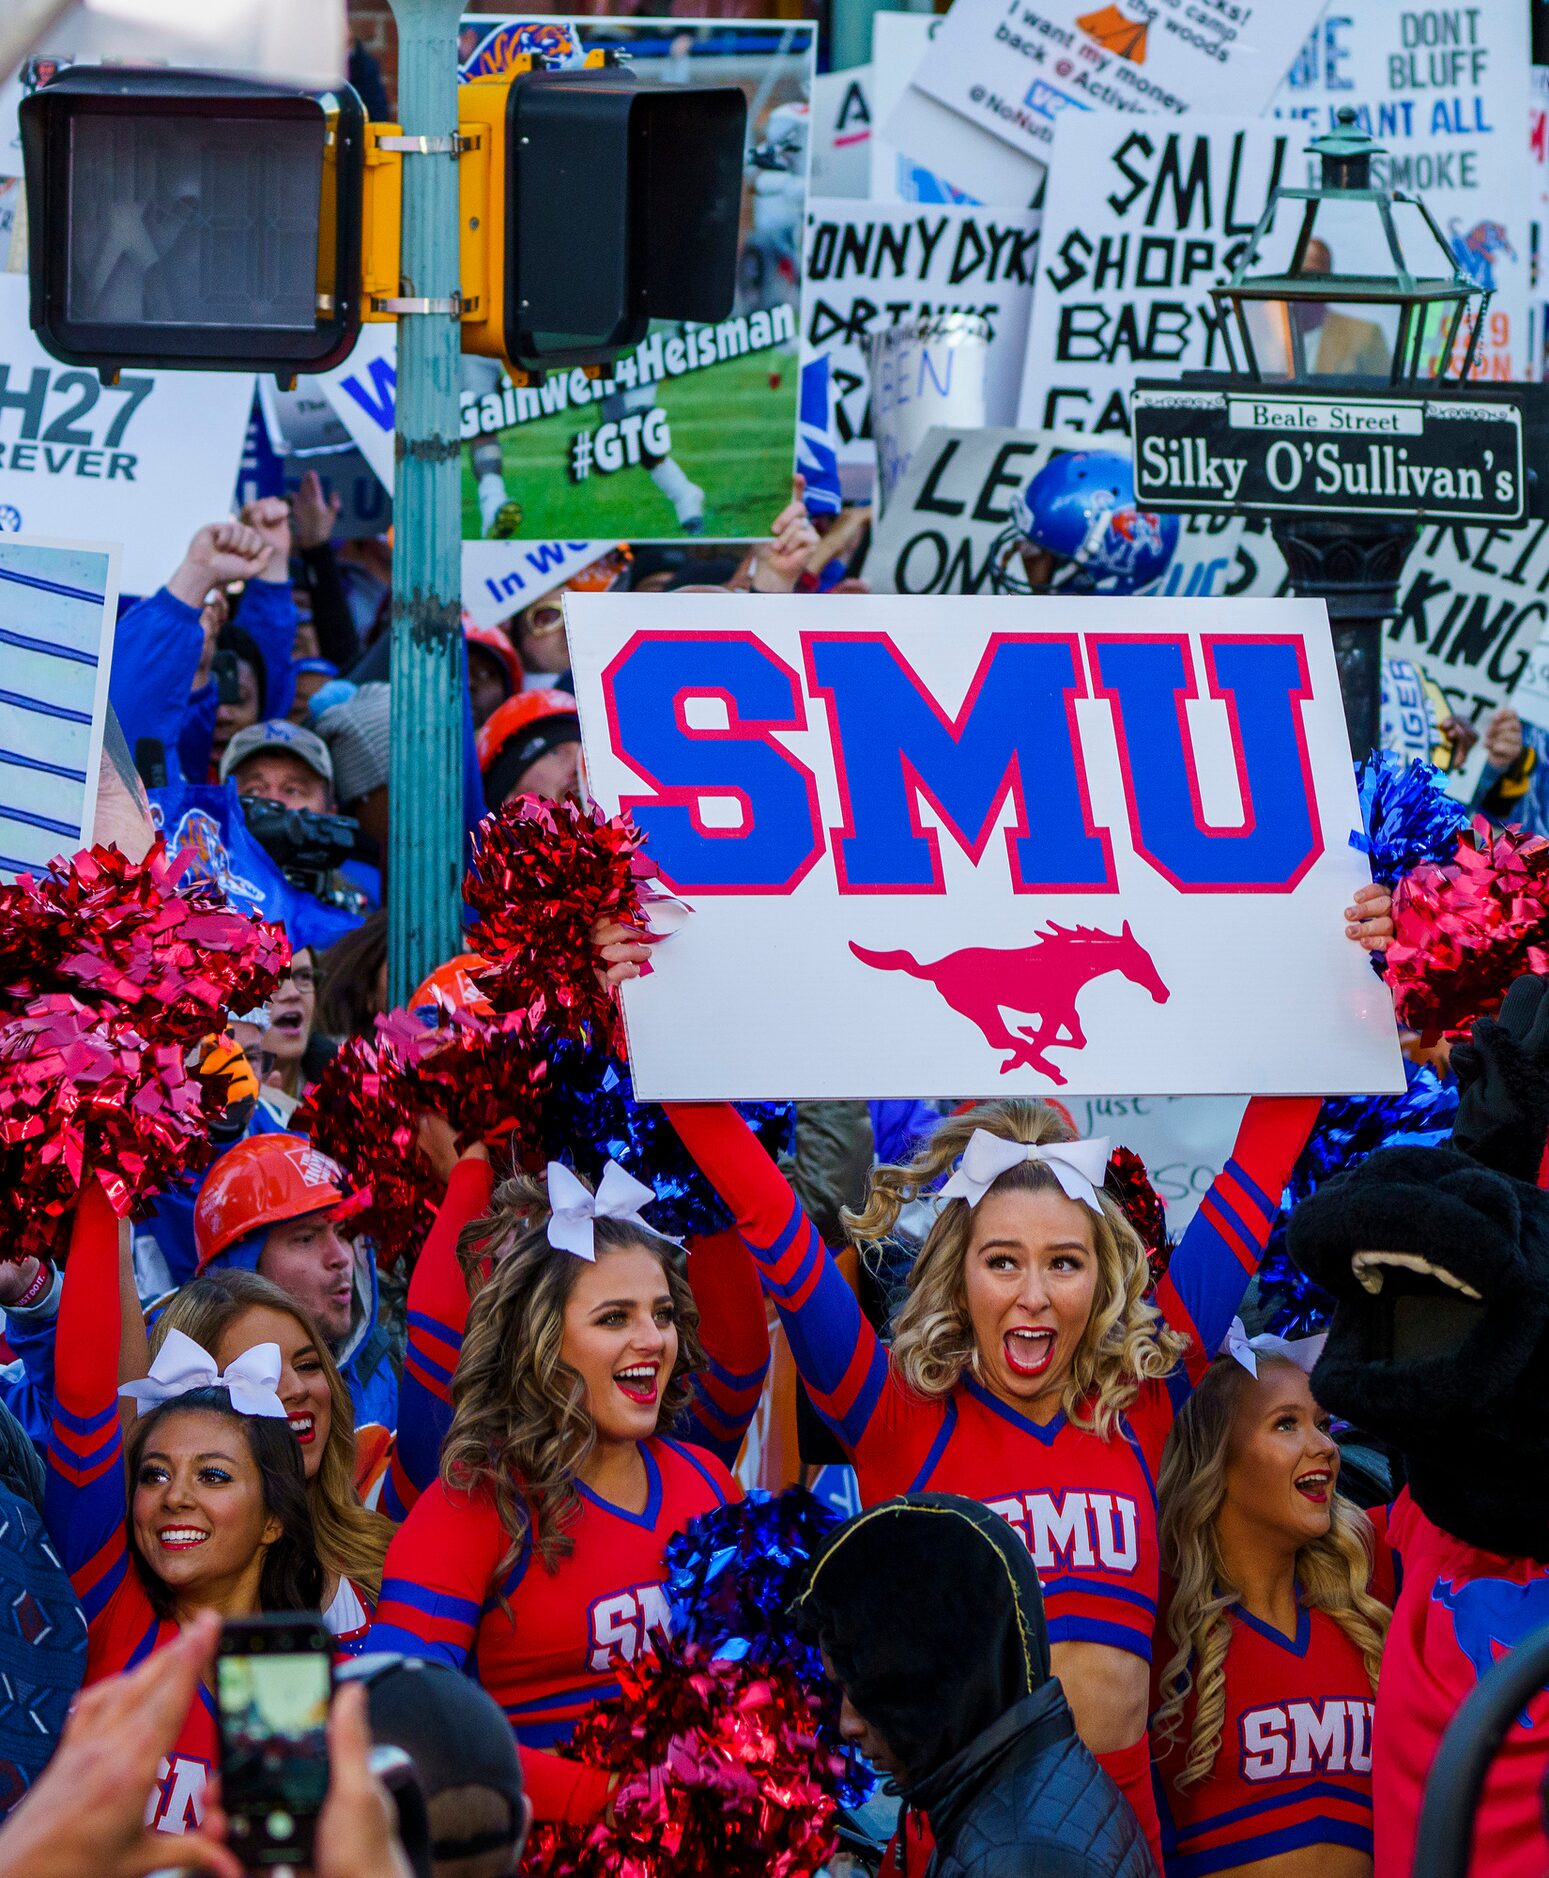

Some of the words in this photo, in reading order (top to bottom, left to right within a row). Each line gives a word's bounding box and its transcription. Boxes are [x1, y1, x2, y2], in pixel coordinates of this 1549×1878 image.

[994, 22, 1046, 65] back
[1165, 17, 1229, 63] woods
[1401, 9, 1481, 49] DONT
[1022, 9, 1076, 49] want
[1077, 42, 1111, 72] my
[1115, 64, 1188, 116] money
[1388, 49, 1489, 90] BLUFF
[1431, 96, 1493, 135] ALL
[1106, 129, 1288, 236] SMU
[1371, 152, 1480, 191] SMOKE
[806, 212, 950, 280] ONNY
[1046, 228, 1262, 293] SHOPS
[1056, 300, 1234, 367] BABY
[572, 406, 672, 482] #GTG
[1252, 405, 1318, 428] Beale
[1329, 407, 1400, 432] Street
[0, 443, 138, 482] EVER
[1142, 435, 1248, 500] Silky
[1266, 440, 1515, 502] O'Sullivan's
[485, 574, 526, 603] In
[524, 542, 589, 577] W
[1387, 569, 1548, 695] KING
[601, 629, 1326, 896] SMU
